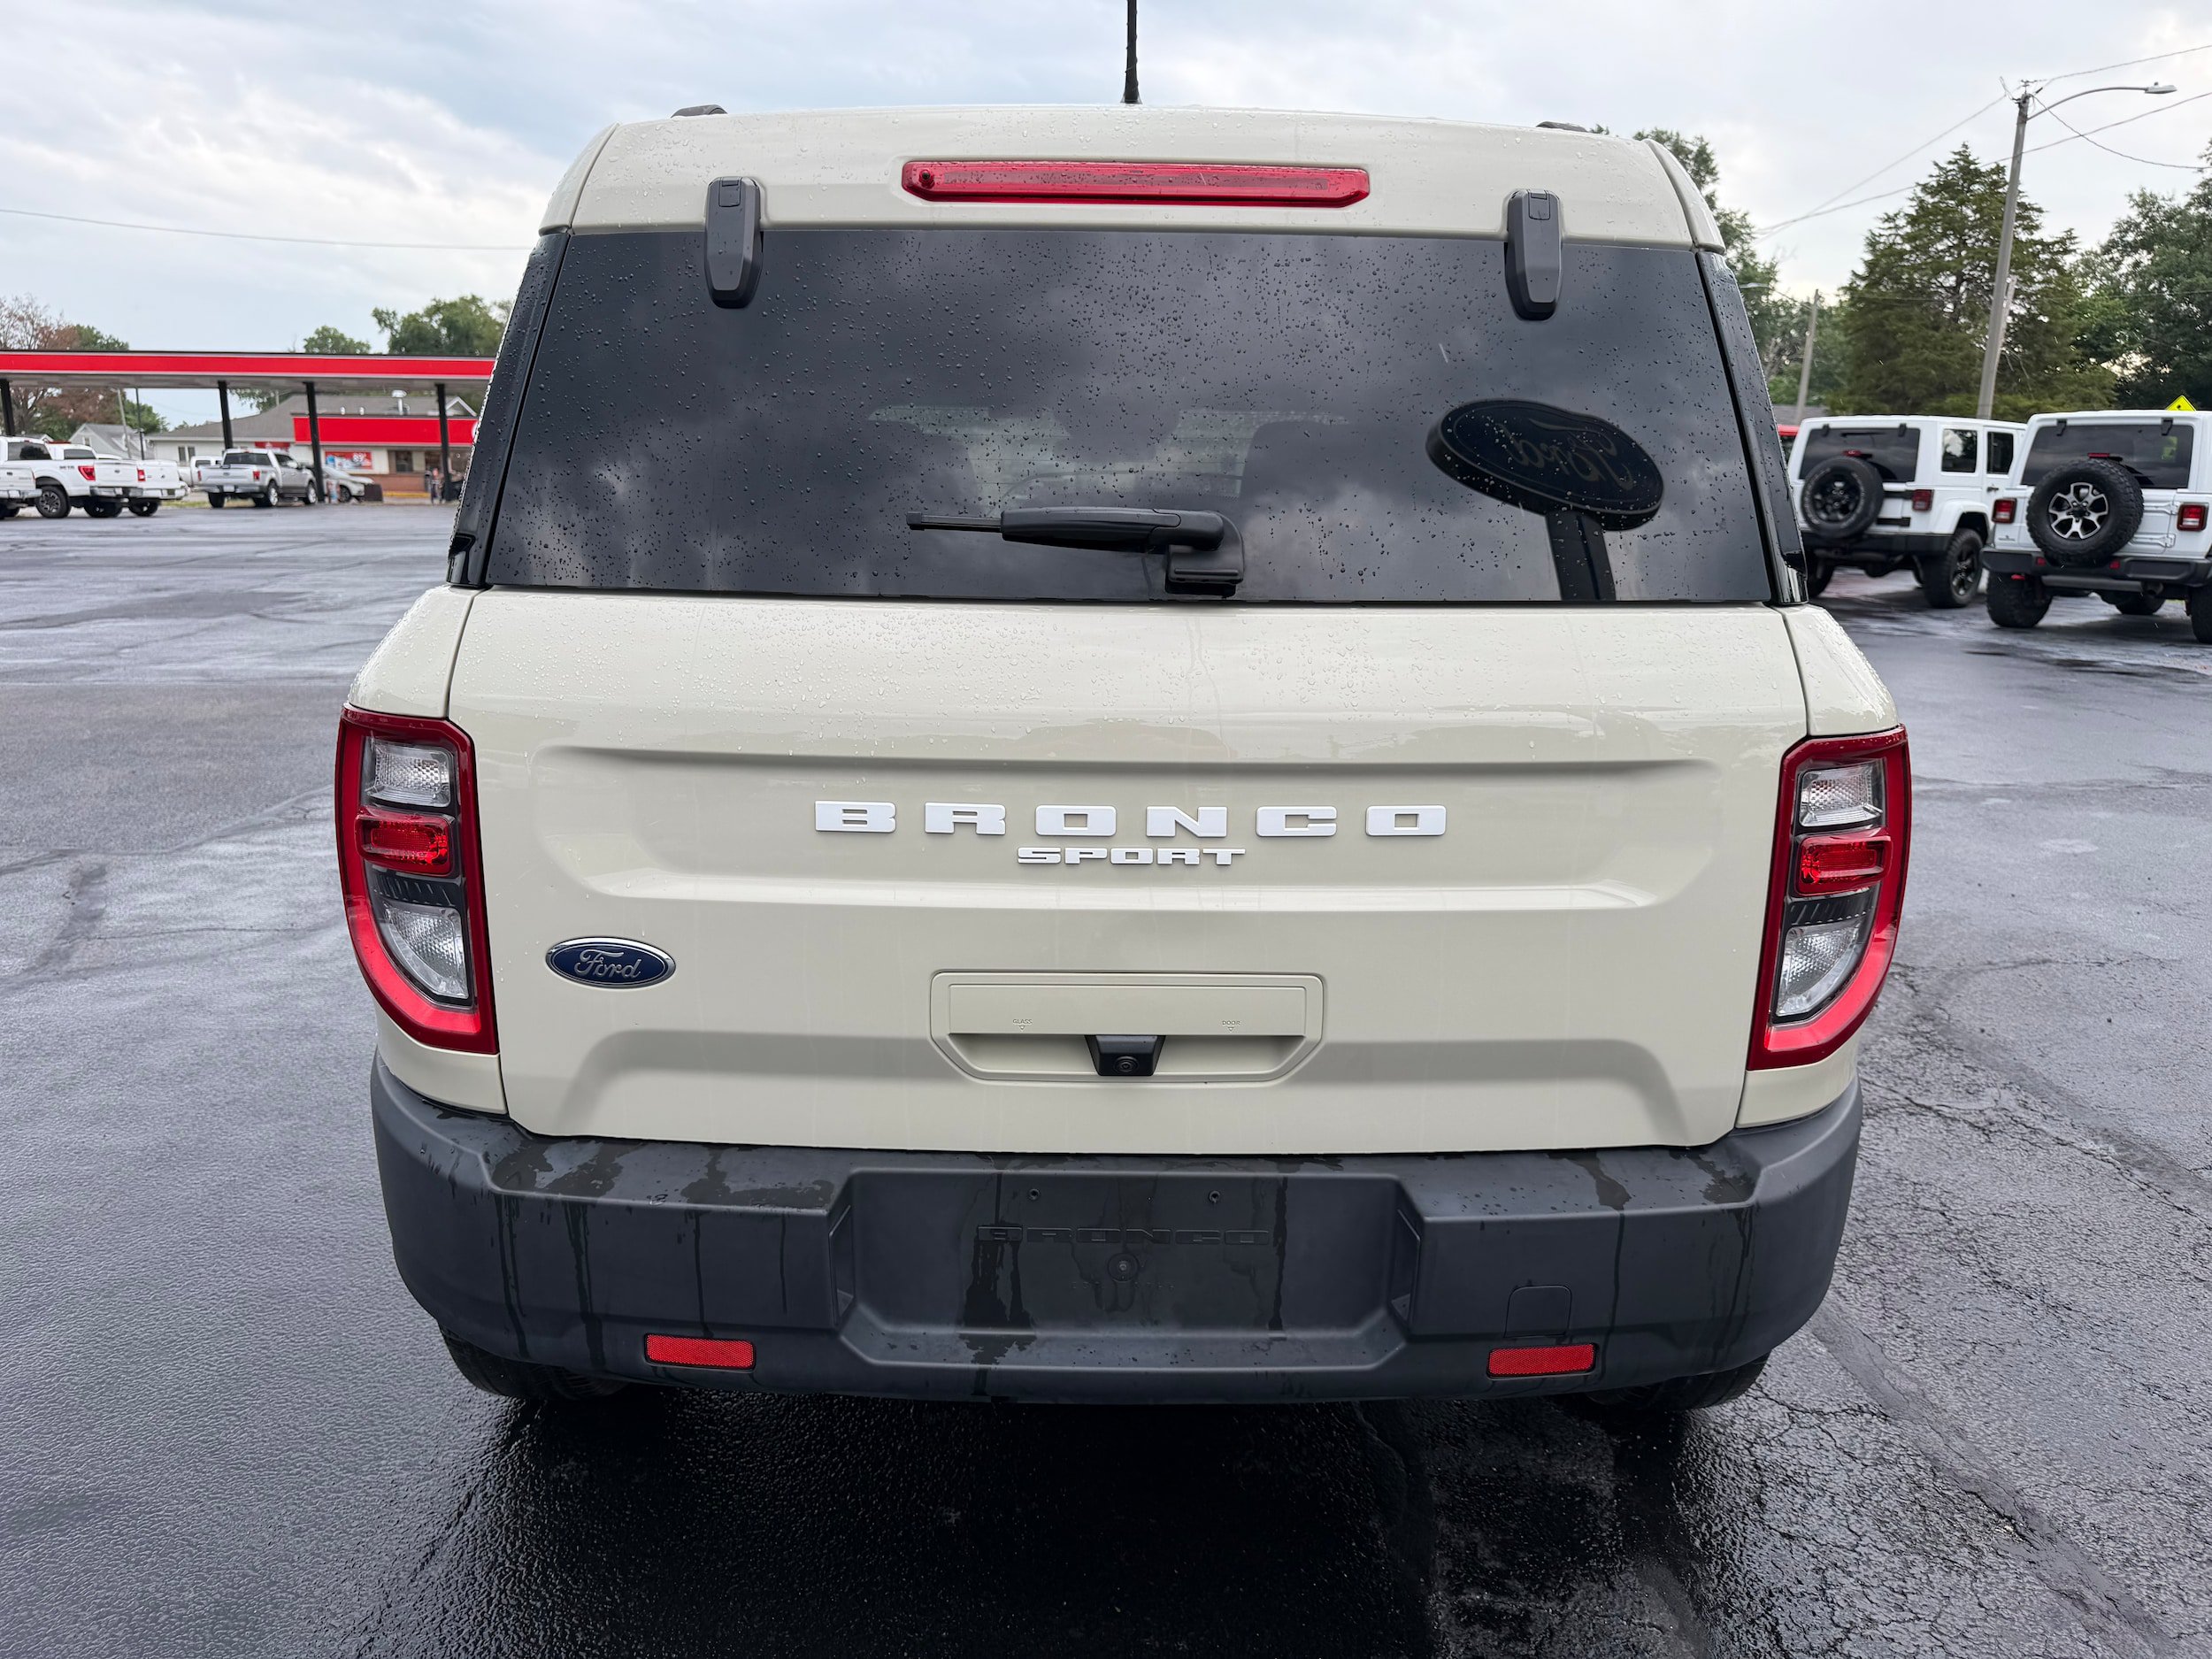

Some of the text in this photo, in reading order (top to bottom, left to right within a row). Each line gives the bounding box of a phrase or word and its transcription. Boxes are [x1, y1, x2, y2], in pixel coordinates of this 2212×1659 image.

[815, 800, 1447, 837] BRONCO
[1017, 846, 1246, 866] SPORT
[573, 949, 642, 979] Ford
[977, 1225, 1270, 1245] BRONCO
